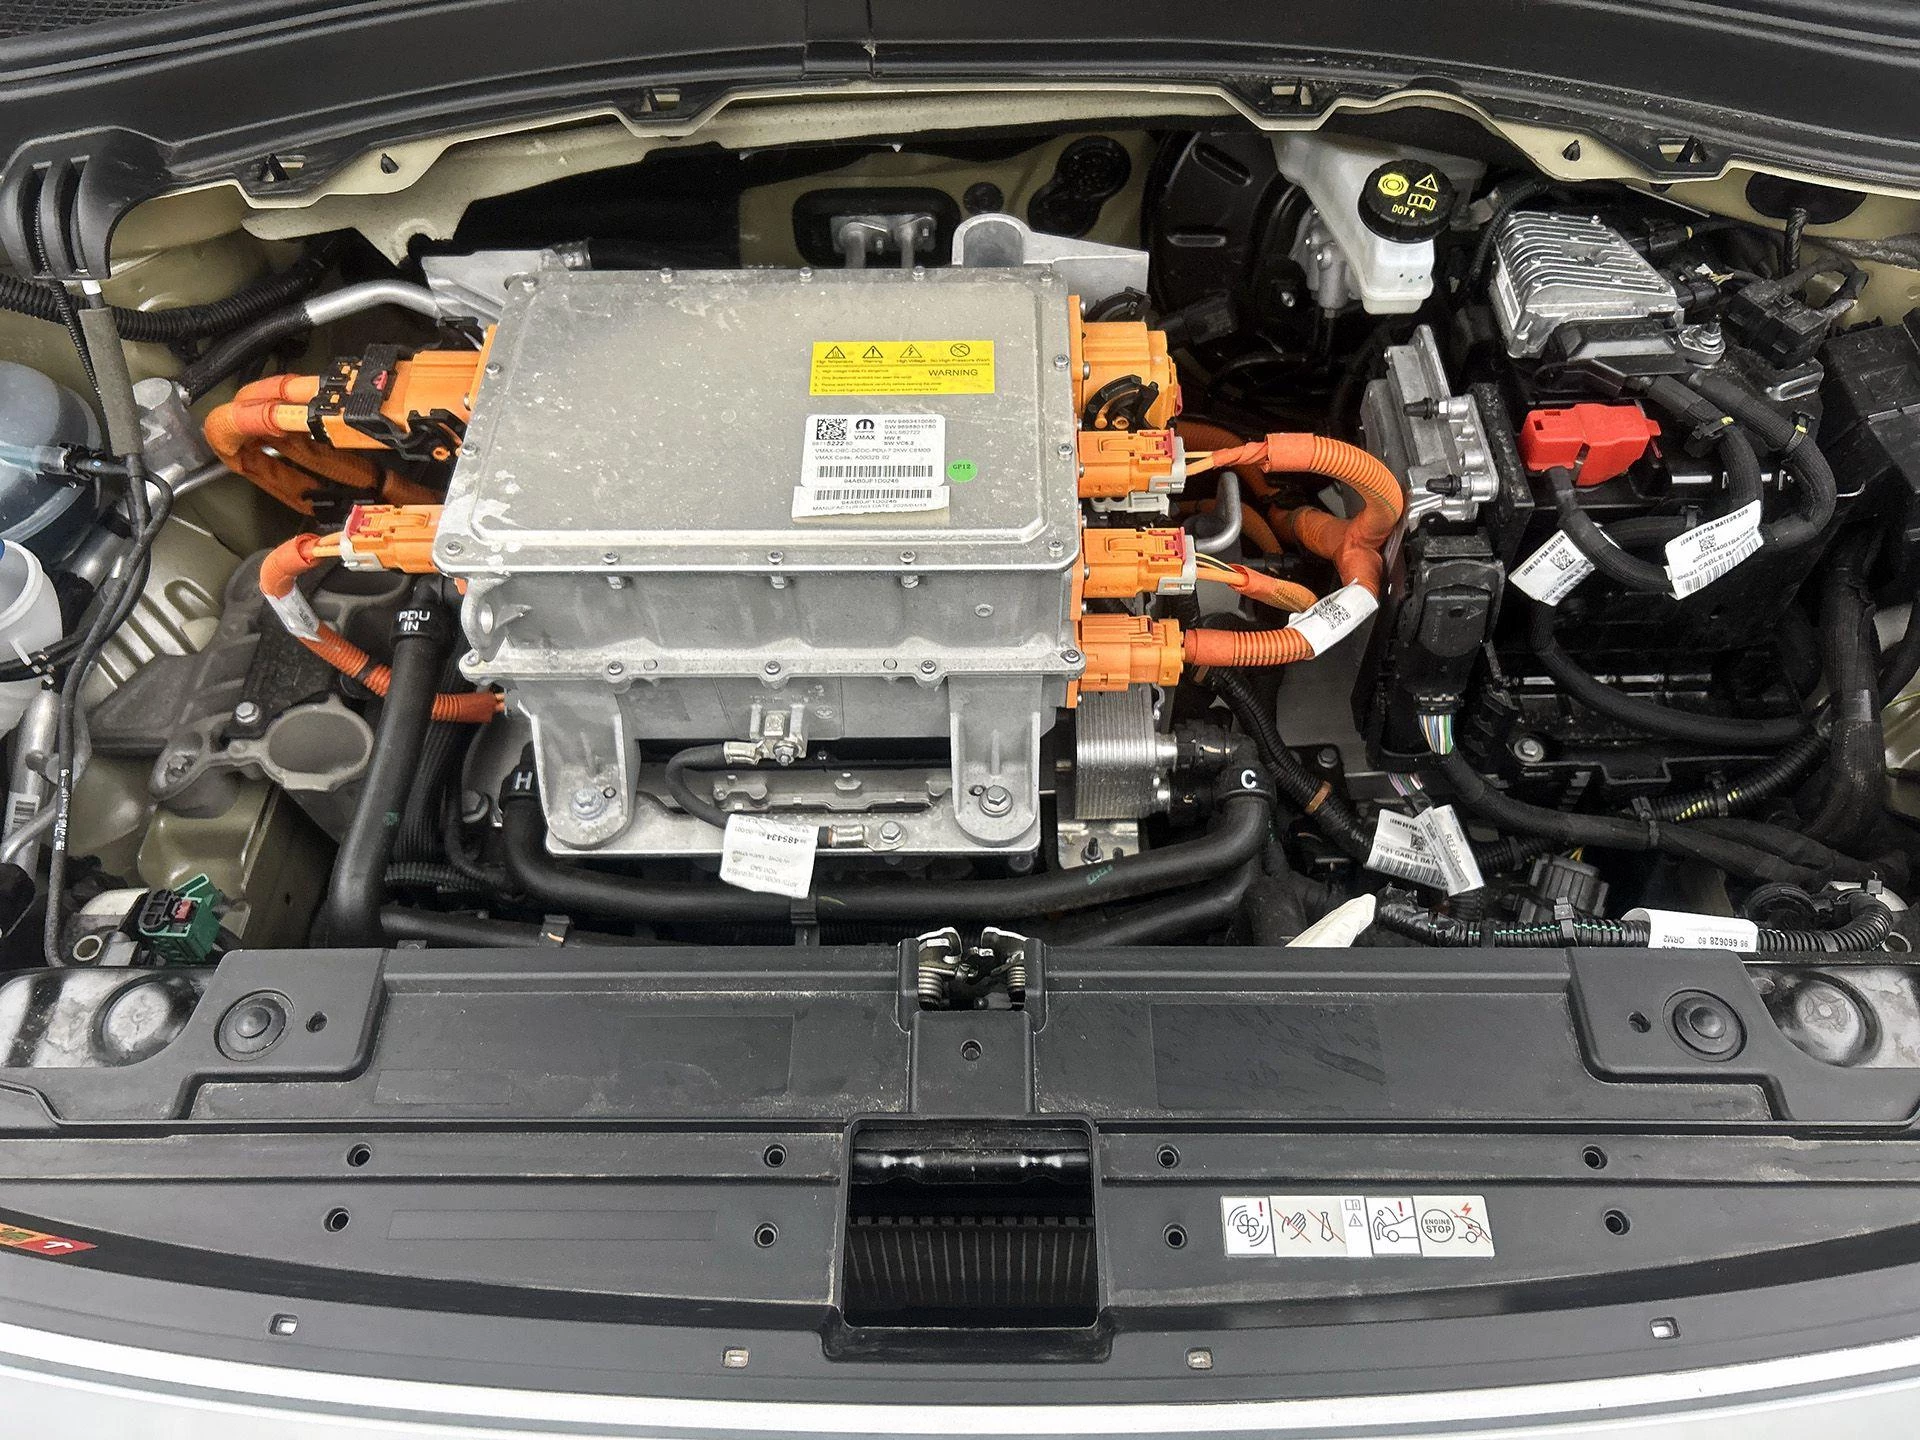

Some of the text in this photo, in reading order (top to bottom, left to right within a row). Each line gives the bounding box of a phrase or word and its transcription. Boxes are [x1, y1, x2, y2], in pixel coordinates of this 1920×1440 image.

[1391, 204, 1415, 218] DOT 4
[928, 368, 978, 376] WARNING
[1698, 554, 1724, 570] CABLE
[398, 610, 431, 622] PDU
[403, 621, 420, 631] IN
[514, 770, 533, 790] H
[1241, 769, 1257, 789] C
[766, 834, 799, 845] 485434
[1394, 848, 1418, 861] CABLE
[1663, 935, 1685, 945] ORM2
[1709, 936, 1738, 947] 660628
[1426, 1225, 1451, 1234] STOP
